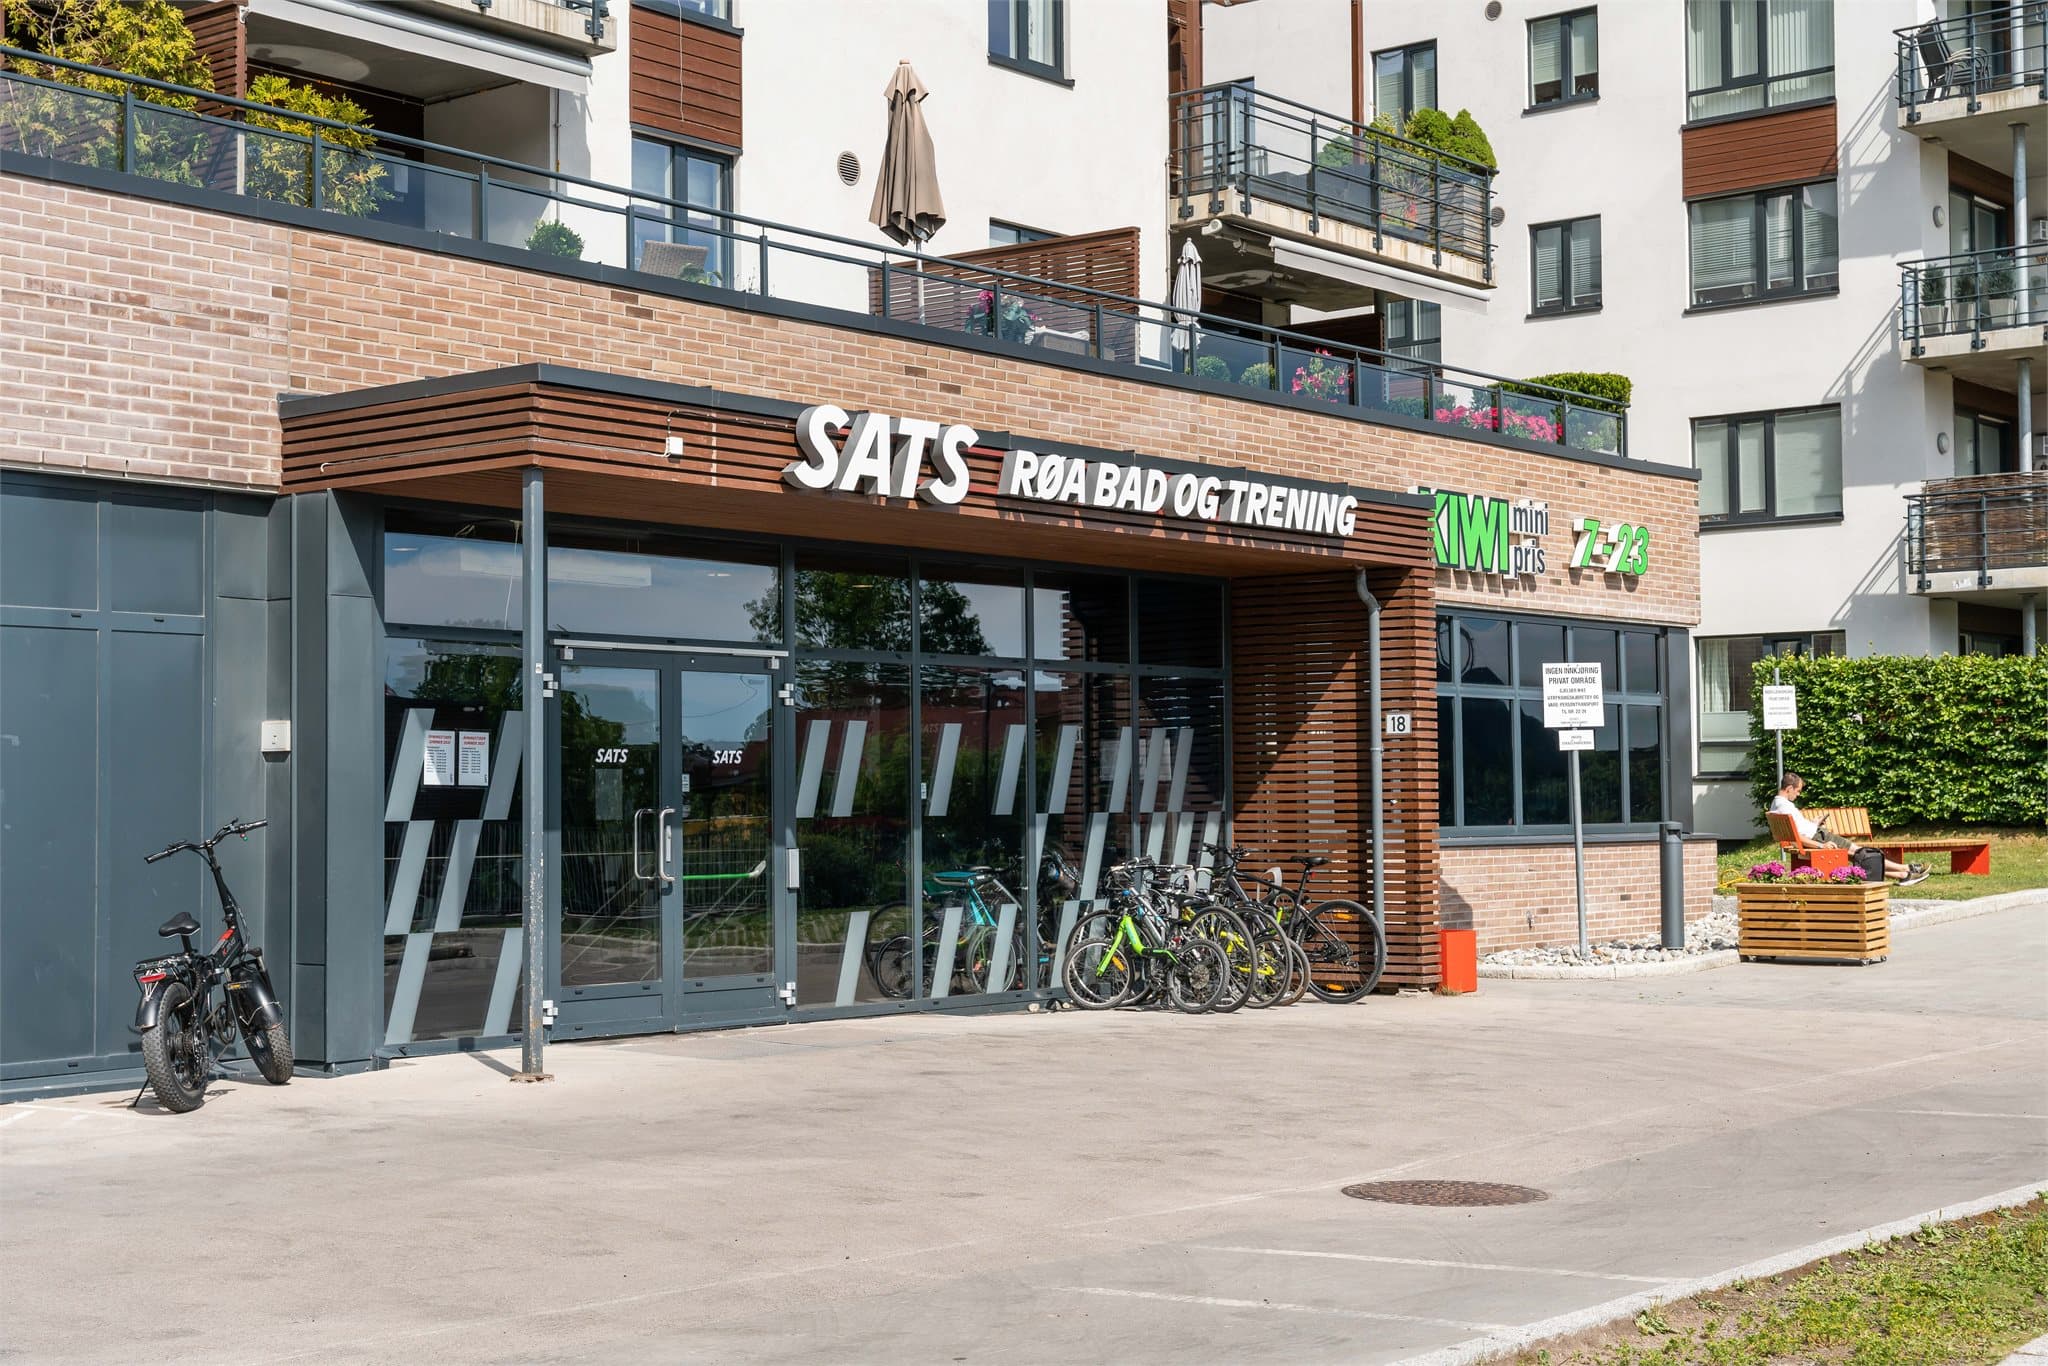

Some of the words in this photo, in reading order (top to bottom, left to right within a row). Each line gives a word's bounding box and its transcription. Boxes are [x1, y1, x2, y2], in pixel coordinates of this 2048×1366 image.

[790, 404, 980, 505] SATS
[1009, 449, 1087, 503] RØA
[1092, 462, 1168, 514] BAD
[1173, 473, 1221, 521] OG
[1226, 480, 1358, 537] TRENING
[1513, 501, 1549, 535] mini
[1513, 540, 1546, 579] pris
[1580, 518, 1650, 576] 7-23
[1545, 667, 1563, 675] INGEN
[1564, 667, 1599, 675] INNKJØRING
[1548, 677, 1570, 685] PRIVAT
[1571, 676, 1597, 684] OMRÅDE
[1391, 716, 1406, 732] 18
[595, 748, 629, 764] SATS
[712, 750, 743, 765] SATS
